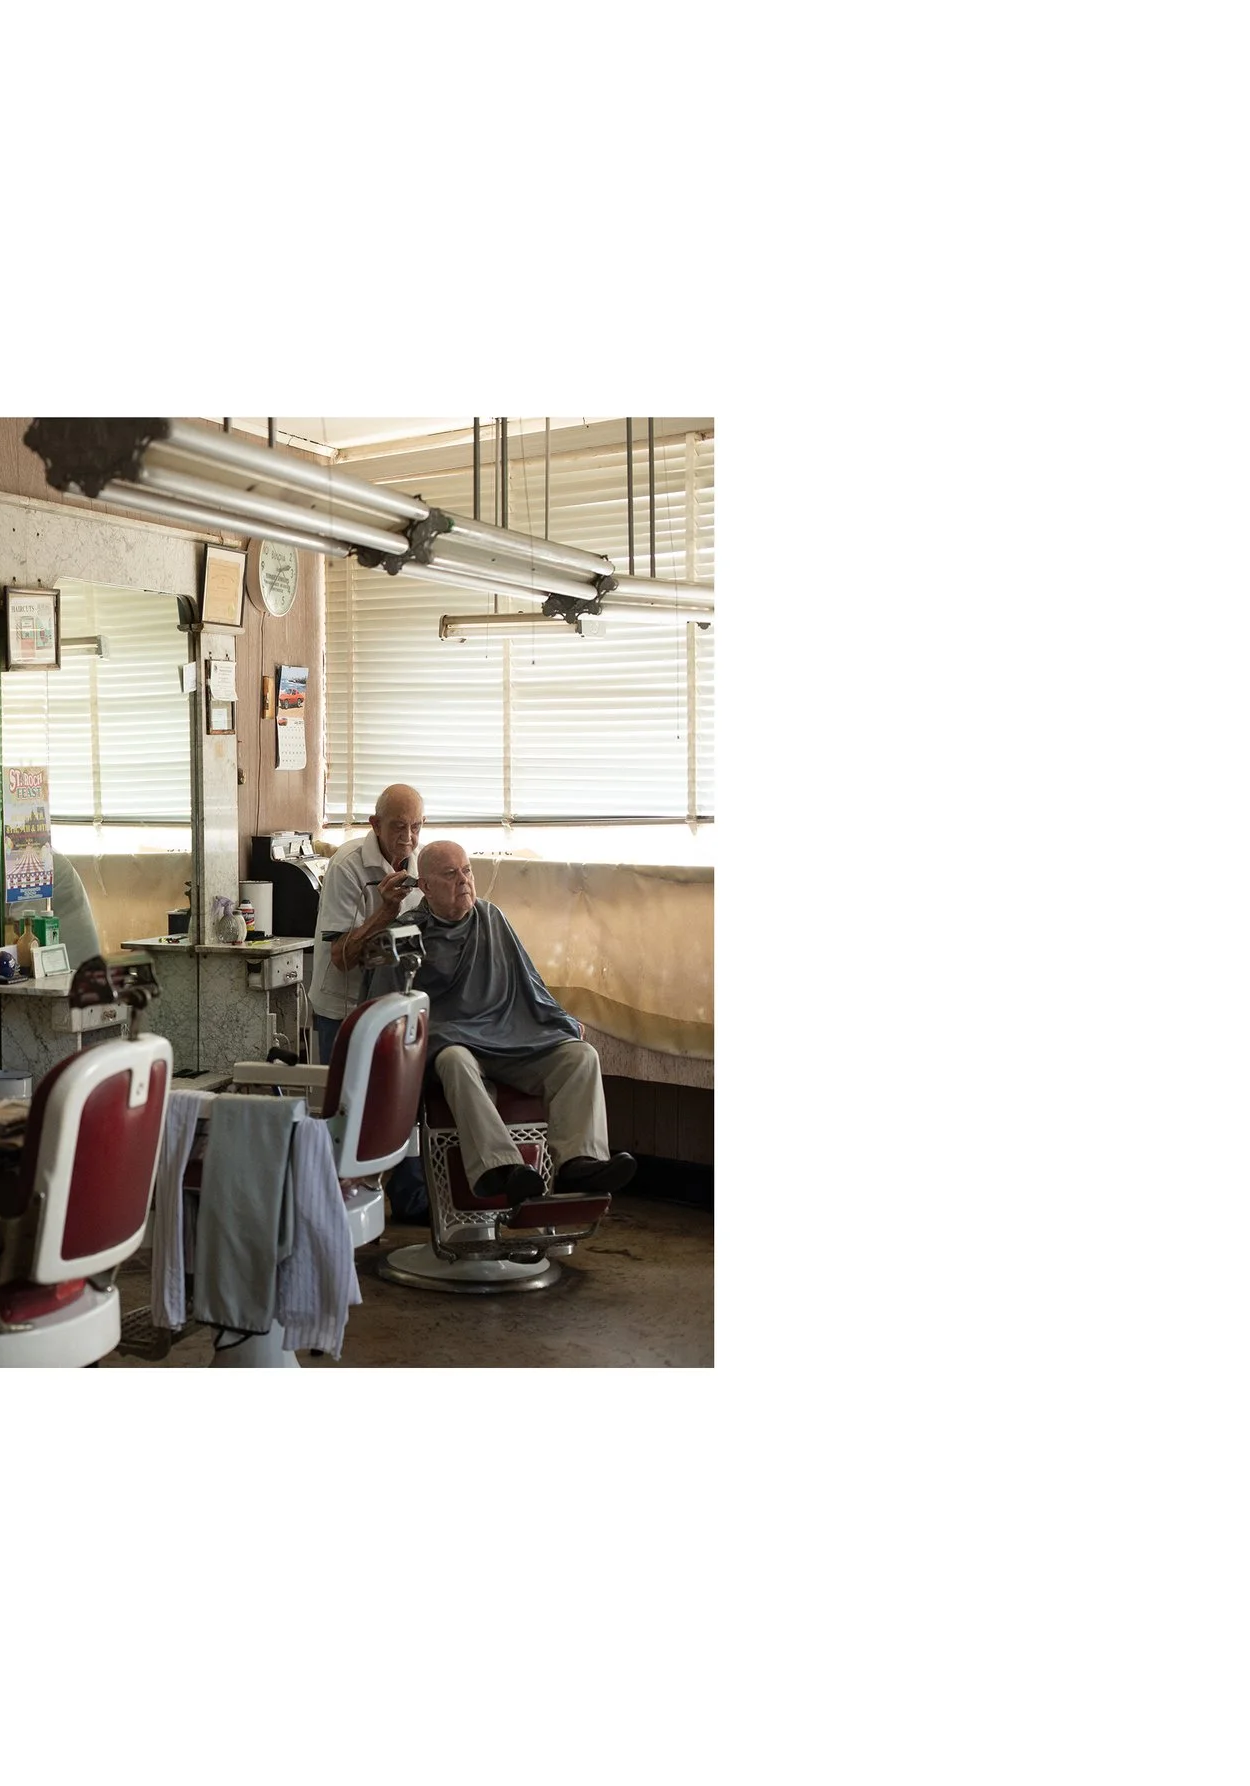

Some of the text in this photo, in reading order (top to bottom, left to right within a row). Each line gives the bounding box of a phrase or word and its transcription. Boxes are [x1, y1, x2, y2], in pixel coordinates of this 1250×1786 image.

[11, 605, 35, 613] HAIRCUTS
[23, 771, 43, 787] ROCH
[16, 786, 42, 799] FEAST
